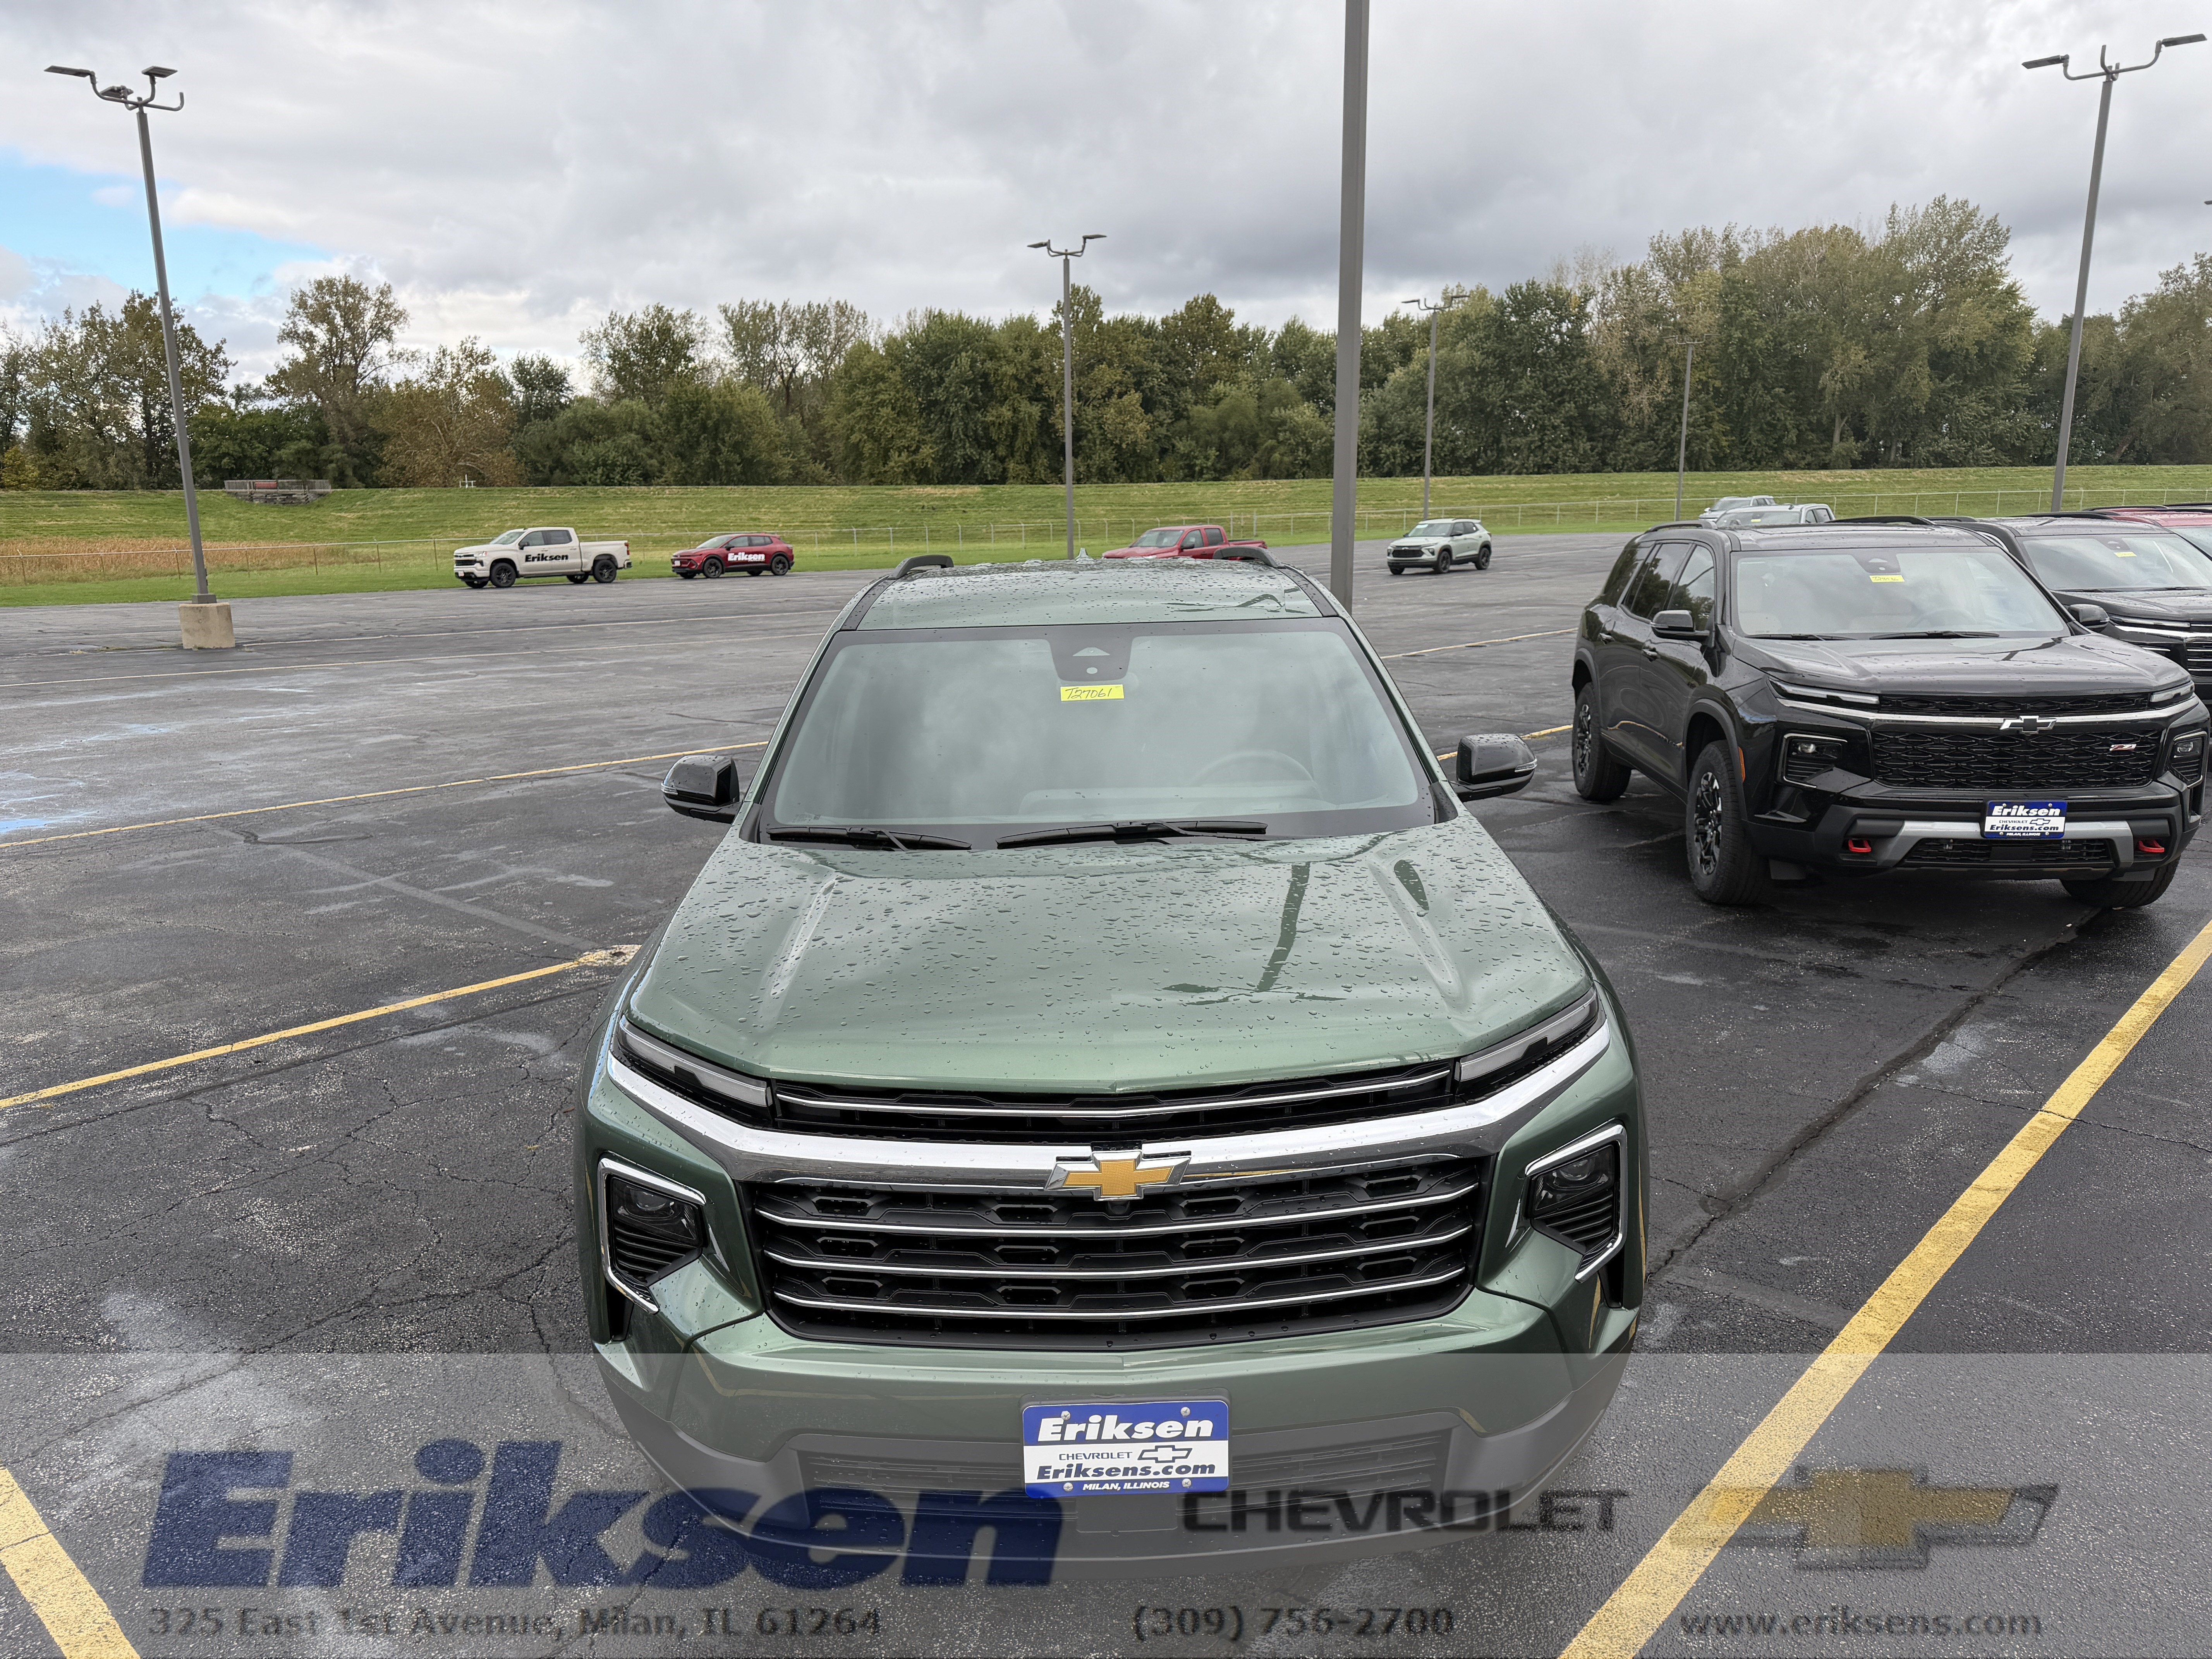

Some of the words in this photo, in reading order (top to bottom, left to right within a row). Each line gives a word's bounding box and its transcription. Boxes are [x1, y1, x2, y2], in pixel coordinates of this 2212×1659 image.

[525, 553, 568, 562] Eriksen
[728, 552, 765, 561] Eriksen
[1065, 687, 1112, 699] T27061
[1992, 805, 2061, 816] Eriksen
[1038, 1415, 1213, 1441] Eriksen
[1059, 1451, 1133, 1461] CHEVROLET
[1037, 1463, 1216, 1480] Eriksens.com
[1082, 1482, 1121, 1491] MILAN,
[1123, 1481, 1170, 1489] ILLINOIS
